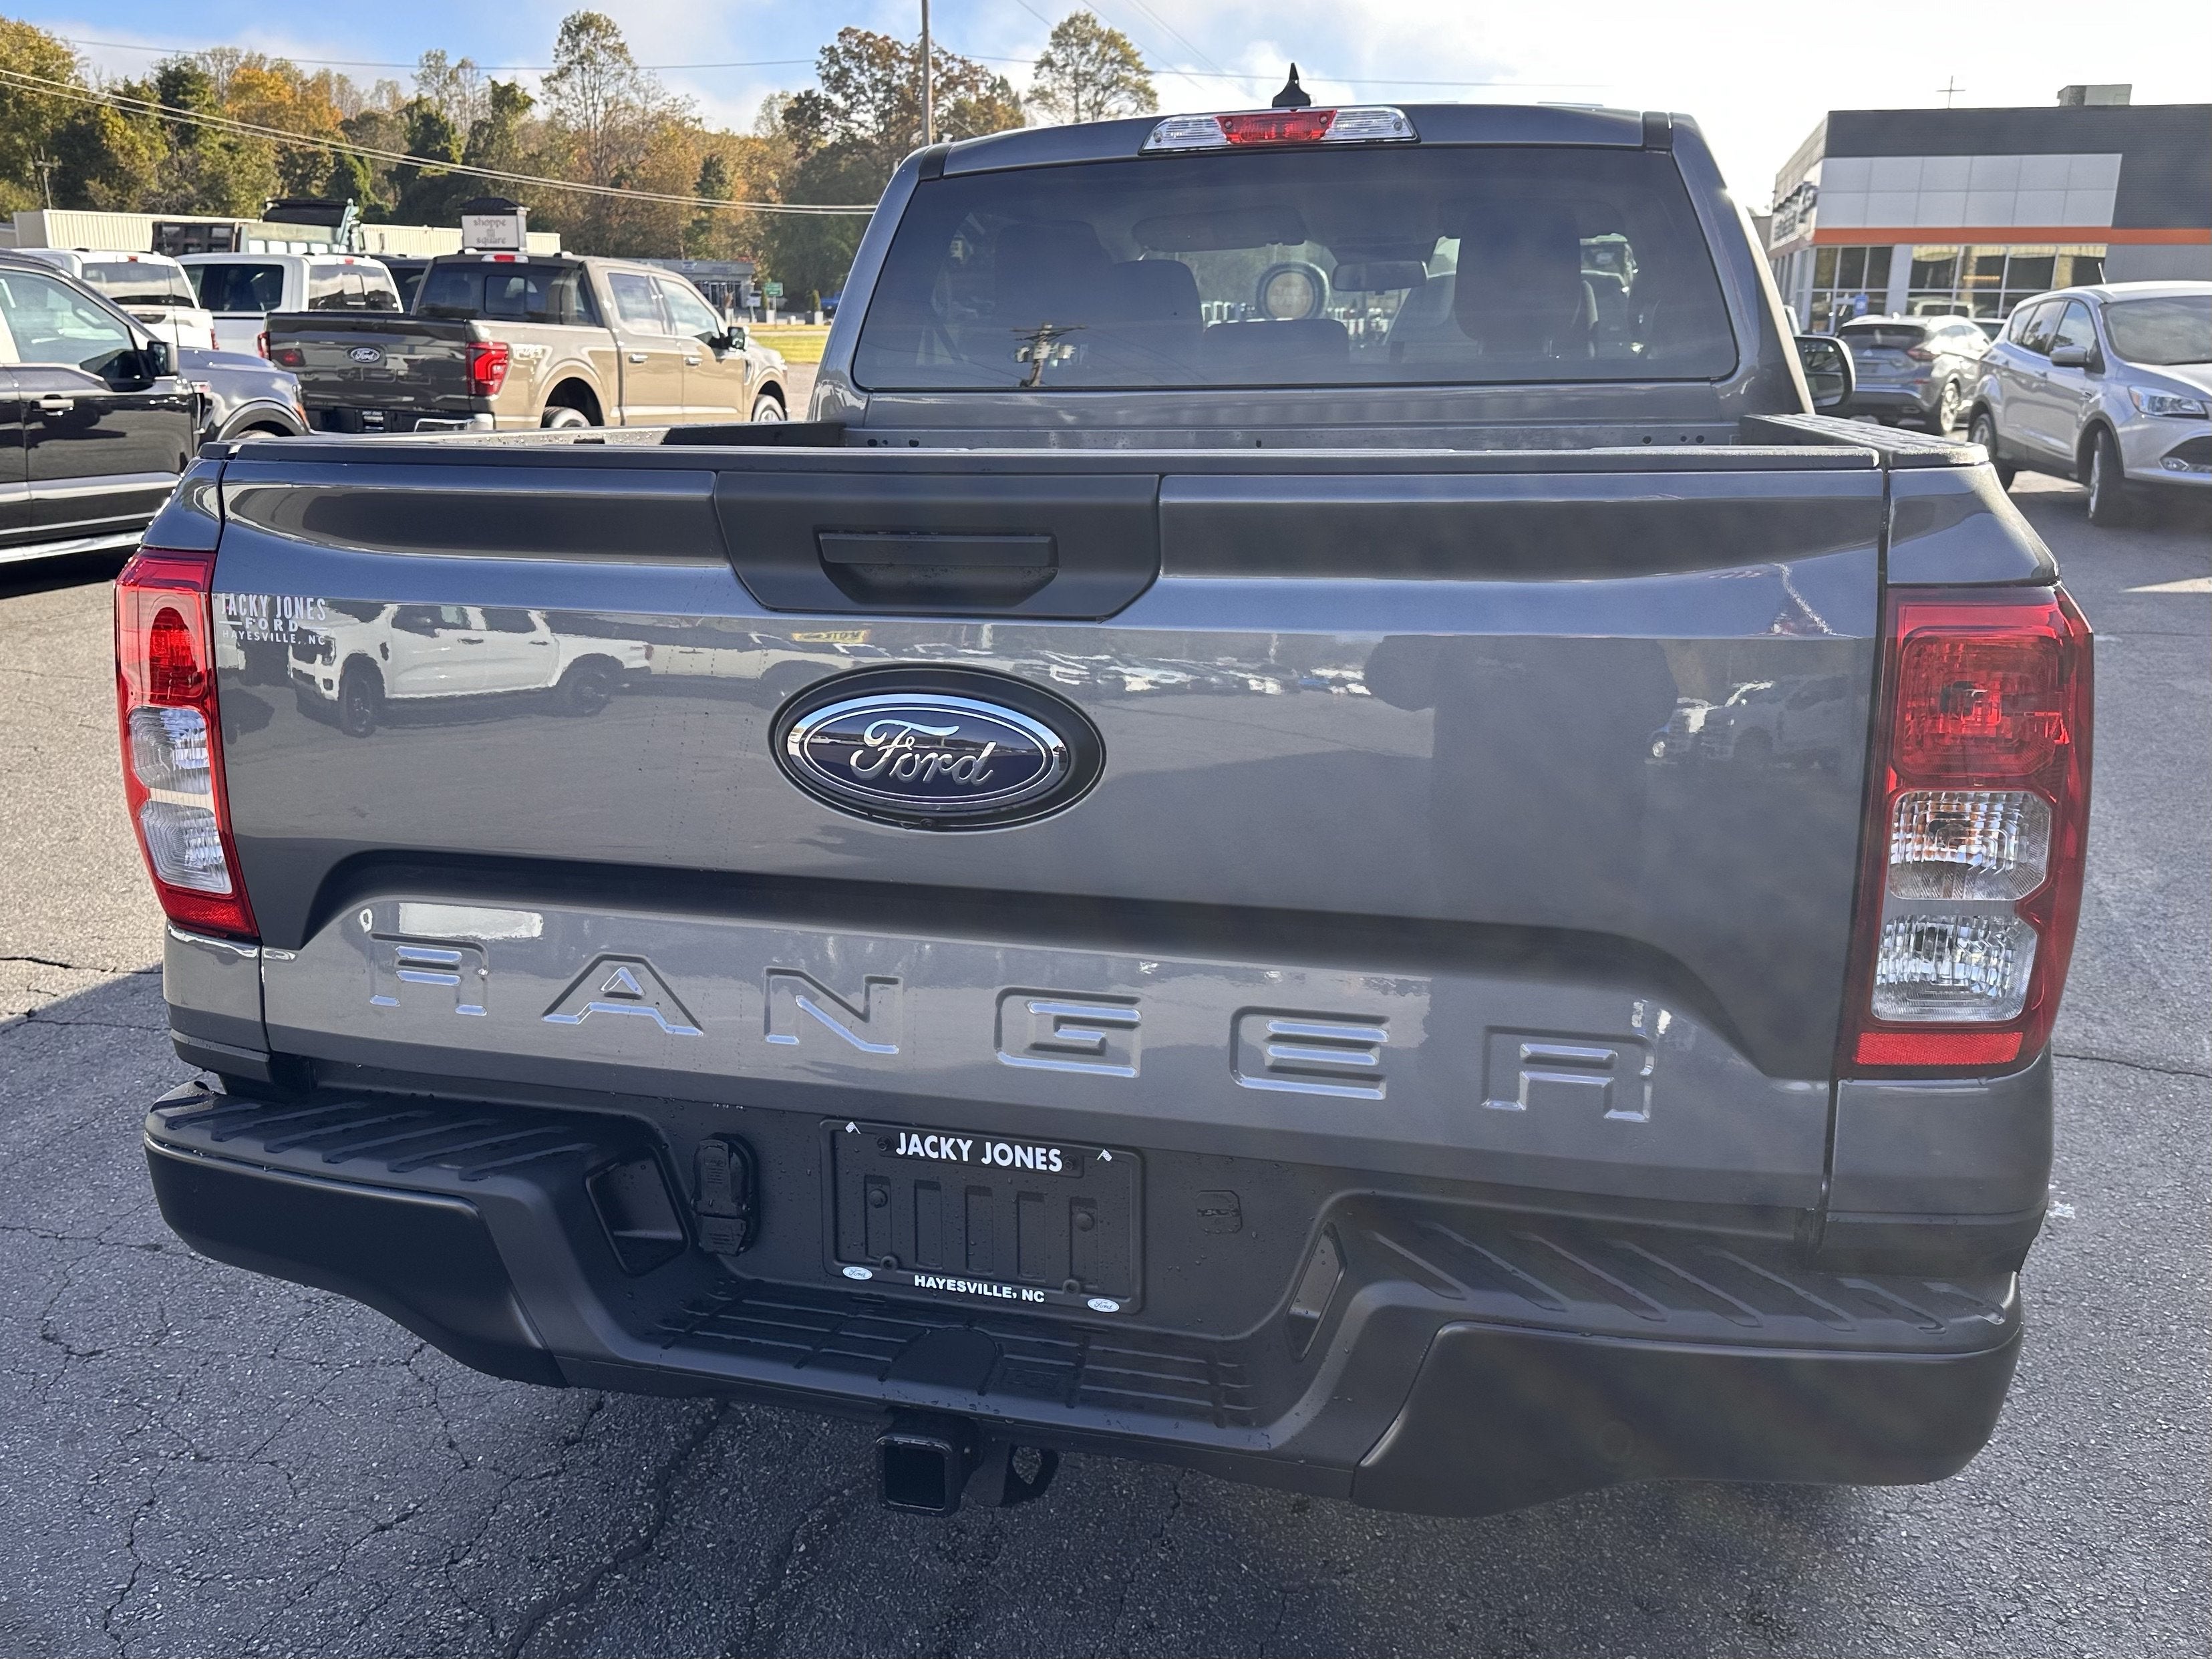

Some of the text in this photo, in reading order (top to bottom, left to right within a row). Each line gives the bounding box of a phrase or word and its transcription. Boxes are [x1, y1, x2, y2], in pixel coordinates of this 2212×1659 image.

[473, 217, 506, 228] shoppe
[476, 237, 506, 246] square
[355, 348, 375, 361] Ford
[221, 593, 326, 621] JACKY JONES
[245, 617, 299, 632] FORD
[222, 630, 326, 645] HAYESVILLE, NC
[849, 719, 997, 787] Ford
[369, 932, 1656, 1123] RANGER
[895, 1132, 1063, 1173] JACKY JONES
[848, 1267, 866, 1278] Ford
[914, 1274, 1045, 1303] HAYESVILLE, NC
[1094, 1300, 1113, 1310] Ford
